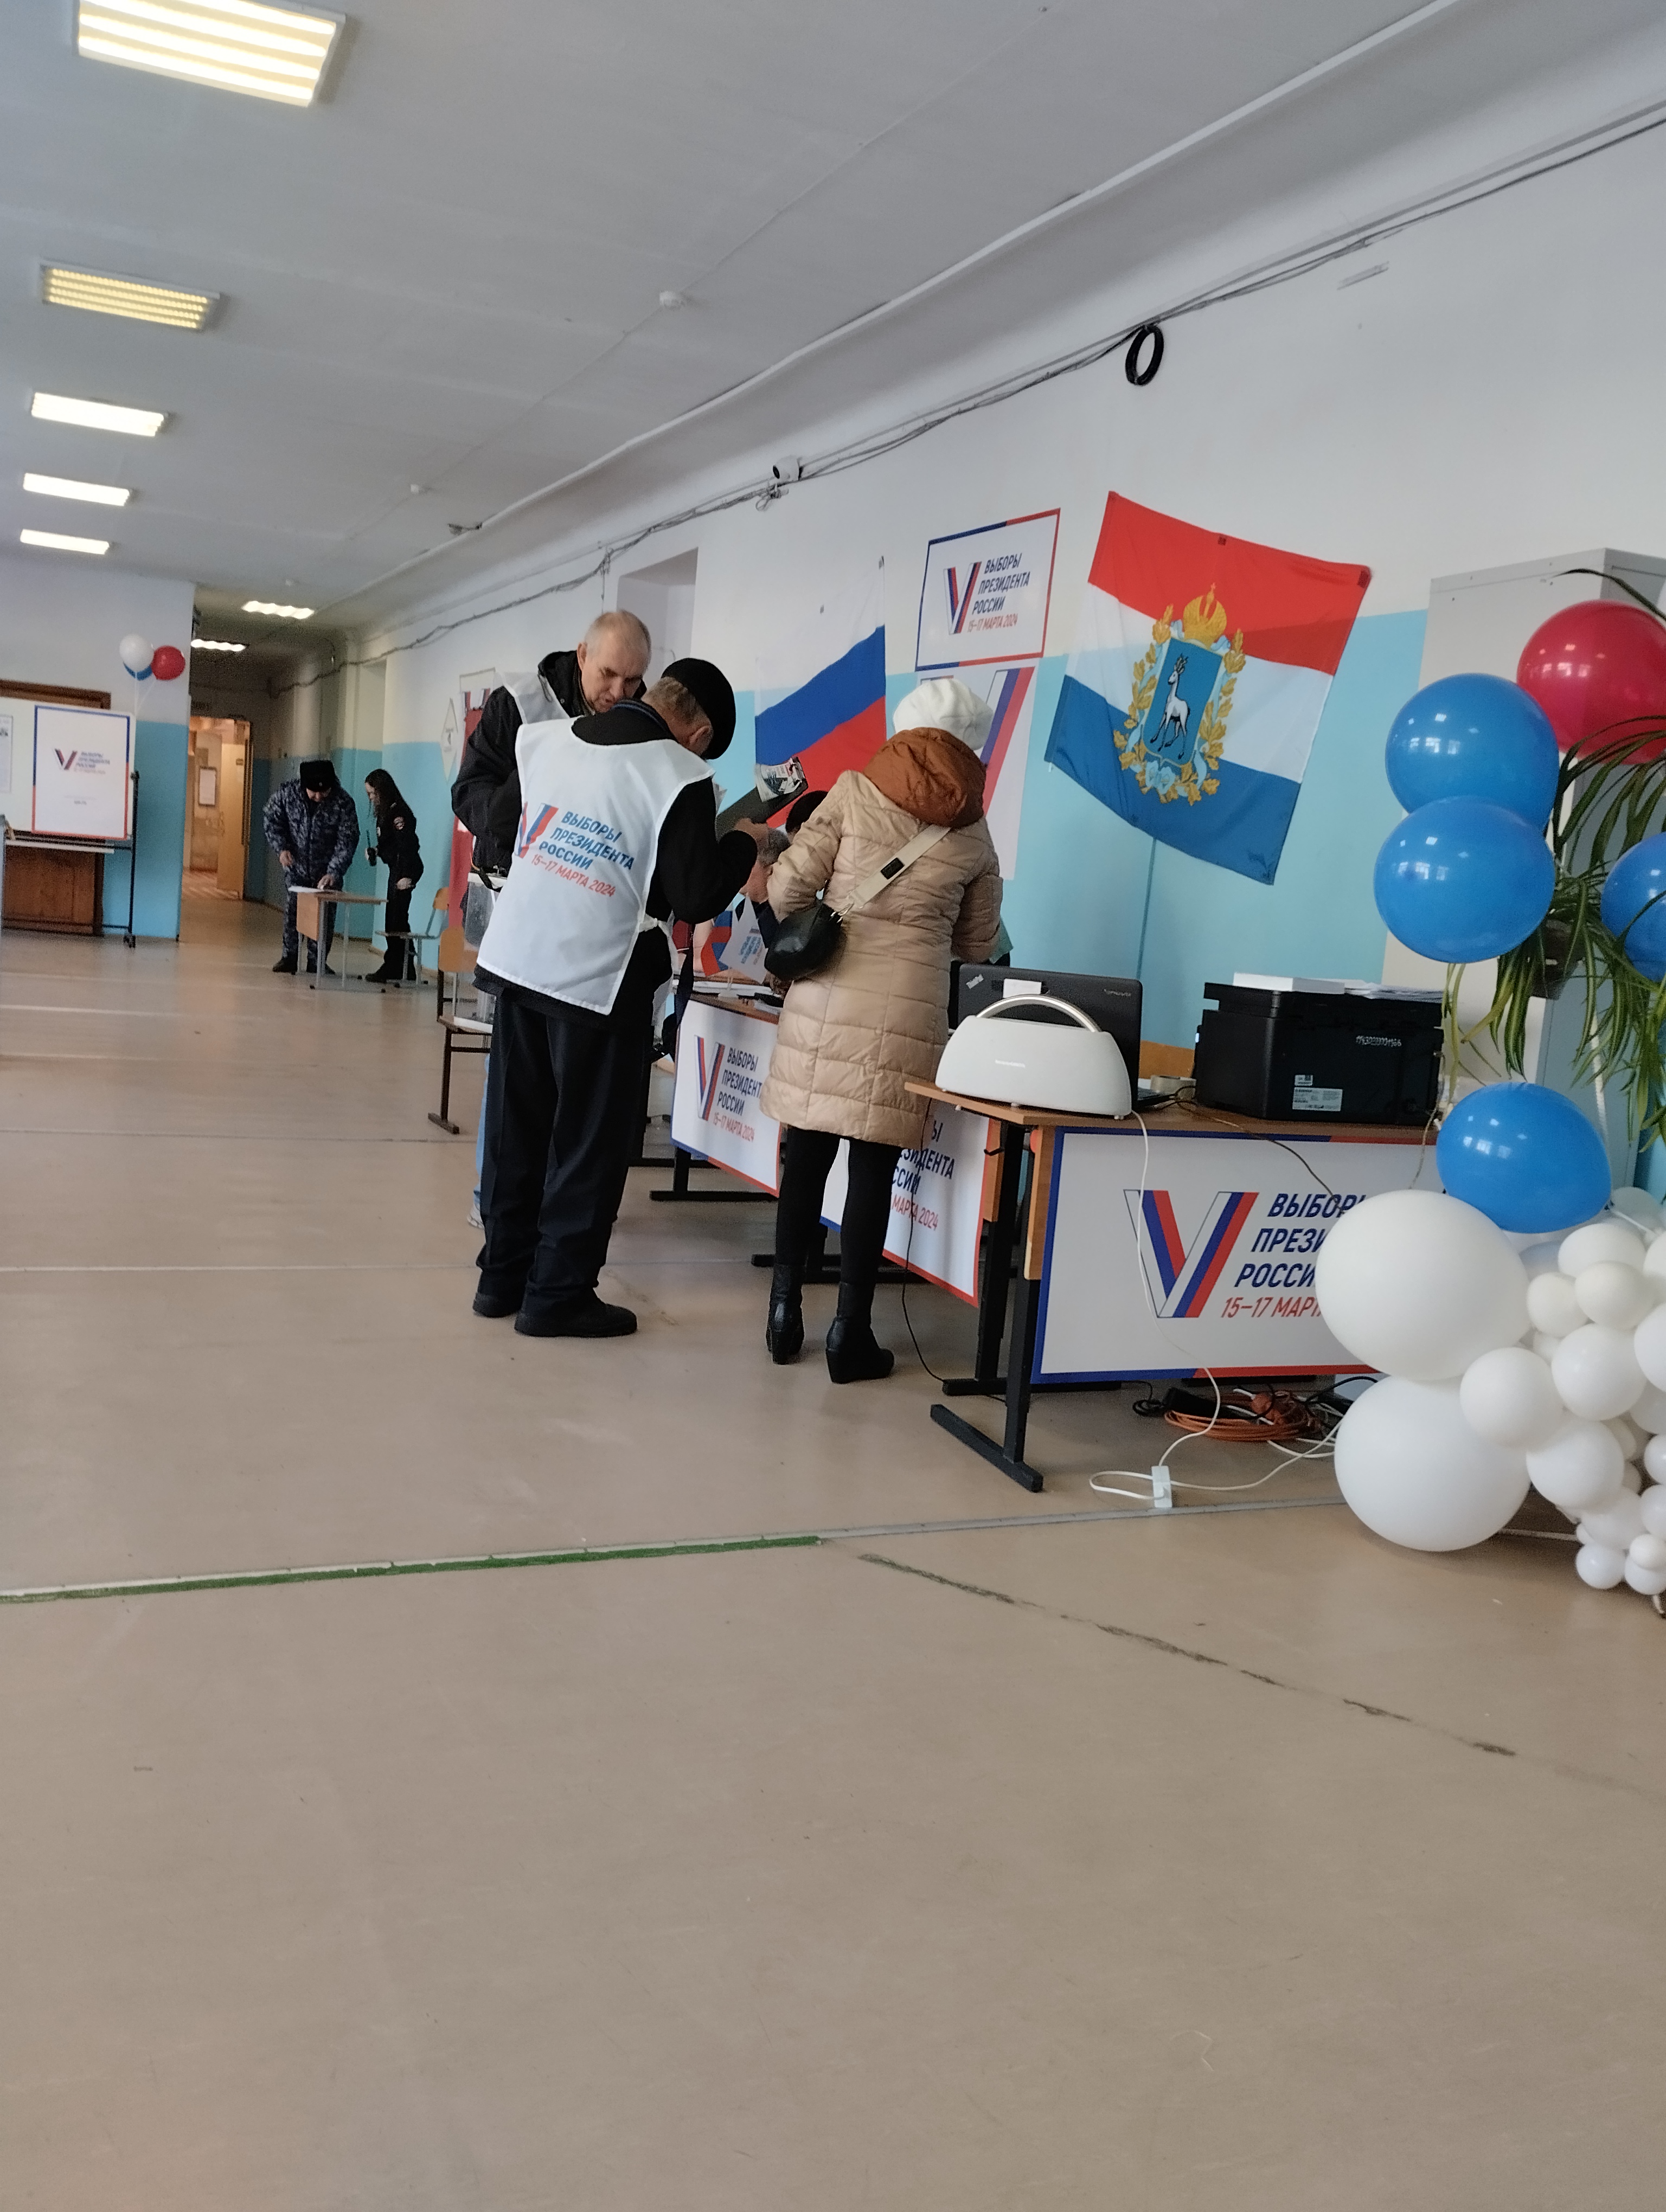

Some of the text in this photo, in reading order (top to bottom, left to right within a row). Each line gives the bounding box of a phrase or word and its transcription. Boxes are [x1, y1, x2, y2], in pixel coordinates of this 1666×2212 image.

[984, 552, 1022, 574] ВЫБОРЫ
[977, 571, 1030, 595] ПРЕЗИДЕНТА
[972, 596, 1006, 615] РОССИИ
[982, 615, 1004, 631] МАРТА
[1002, 613, 1018, 628] 2024
[561, 811, 622, 843] ВЫБОРЫ
[539, 841, 593, 870] РОССИИ
[549, 827, 635, 870] ПРЕЗИДЕНТА
[555, 865, 589, 888] МАРТА
[588, 879, 616, 897] 2024
[727, 1047, 759, 1072] ВЫБОРЫ
[721, 1069, 763, 1099] ПРЕЗИДЕНТ
[716, 1091, 745, 1116] РОССИИ
[725, 1116, 743, 1137] МАРТА
[742, 1124, 755, 1142] 2024
[900, 1148, 955, 1179] ЗИДЕНТА
[1267, 1193, 1366, 1218] ВЫБОР
[918, 1207, 939, 1231] 2024
[1251, 1228, 1328, 1253] ПРЕЗИ
[1234, 1263, 1316, 1288] РОССИ
